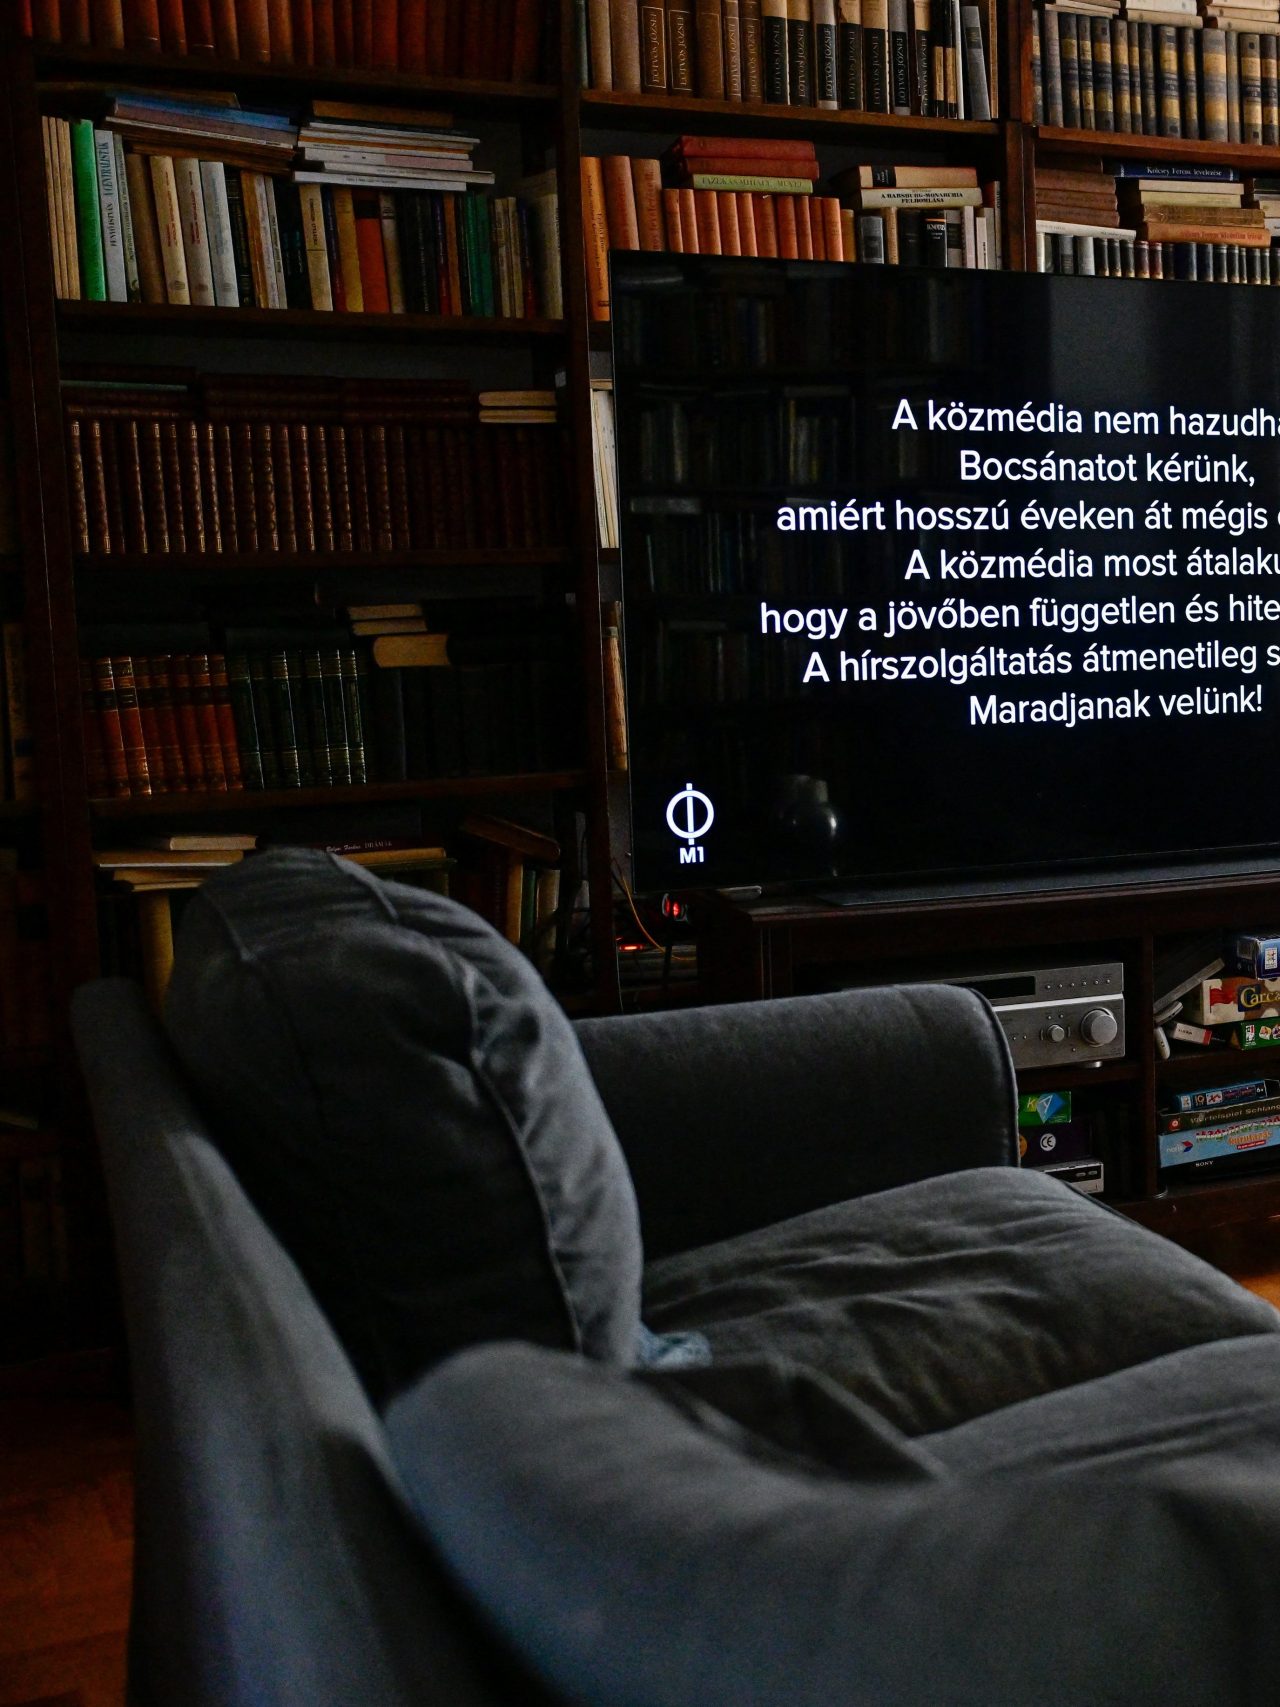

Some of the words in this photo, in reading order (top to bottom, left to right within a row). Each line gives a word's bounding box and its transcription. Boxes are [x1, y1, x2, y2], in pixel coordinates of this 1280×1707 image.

[892, 399, 918, 430] A
[928, 400, 1082, 433] közmédia
[1095, 411, 1158, 434] nem
[961, 450, 1137, 481] Bocsánatot
[1147, 453, 1254, 487] kérünk,
[777, 499, 886, 530] amiért
[896, 499, 1008, 530] hosszú
[1021, 500, 1133, 529] éveken
[1145, 500, 1172, 529] át
[1183, 500, 1268, 536] mégis
[905, 549, 930, 579] A
[941, 548, 1092, 579] közmédia
[1105, 550, 1177, 576] most
[761, 602, 848, 639] hogy
[859, 608, 876, 630] a
[884, 598, 1019, 637] jövőben
[1029, 596, 1174, 632] független
[1186, 594, 1218, 622] és
[803, 652, 830, 682] A
[841, 644, 1072, 684] hírszolgáltatás
[1083, 640, 1256, 673] átmenetileg
[970, 689, 1150, 727] Maradjanak
[1159, 684, 1262, 716] velünk!
[679, 846, 704, 864] M1
[1195, 1160, 1214, 1168] SONY
